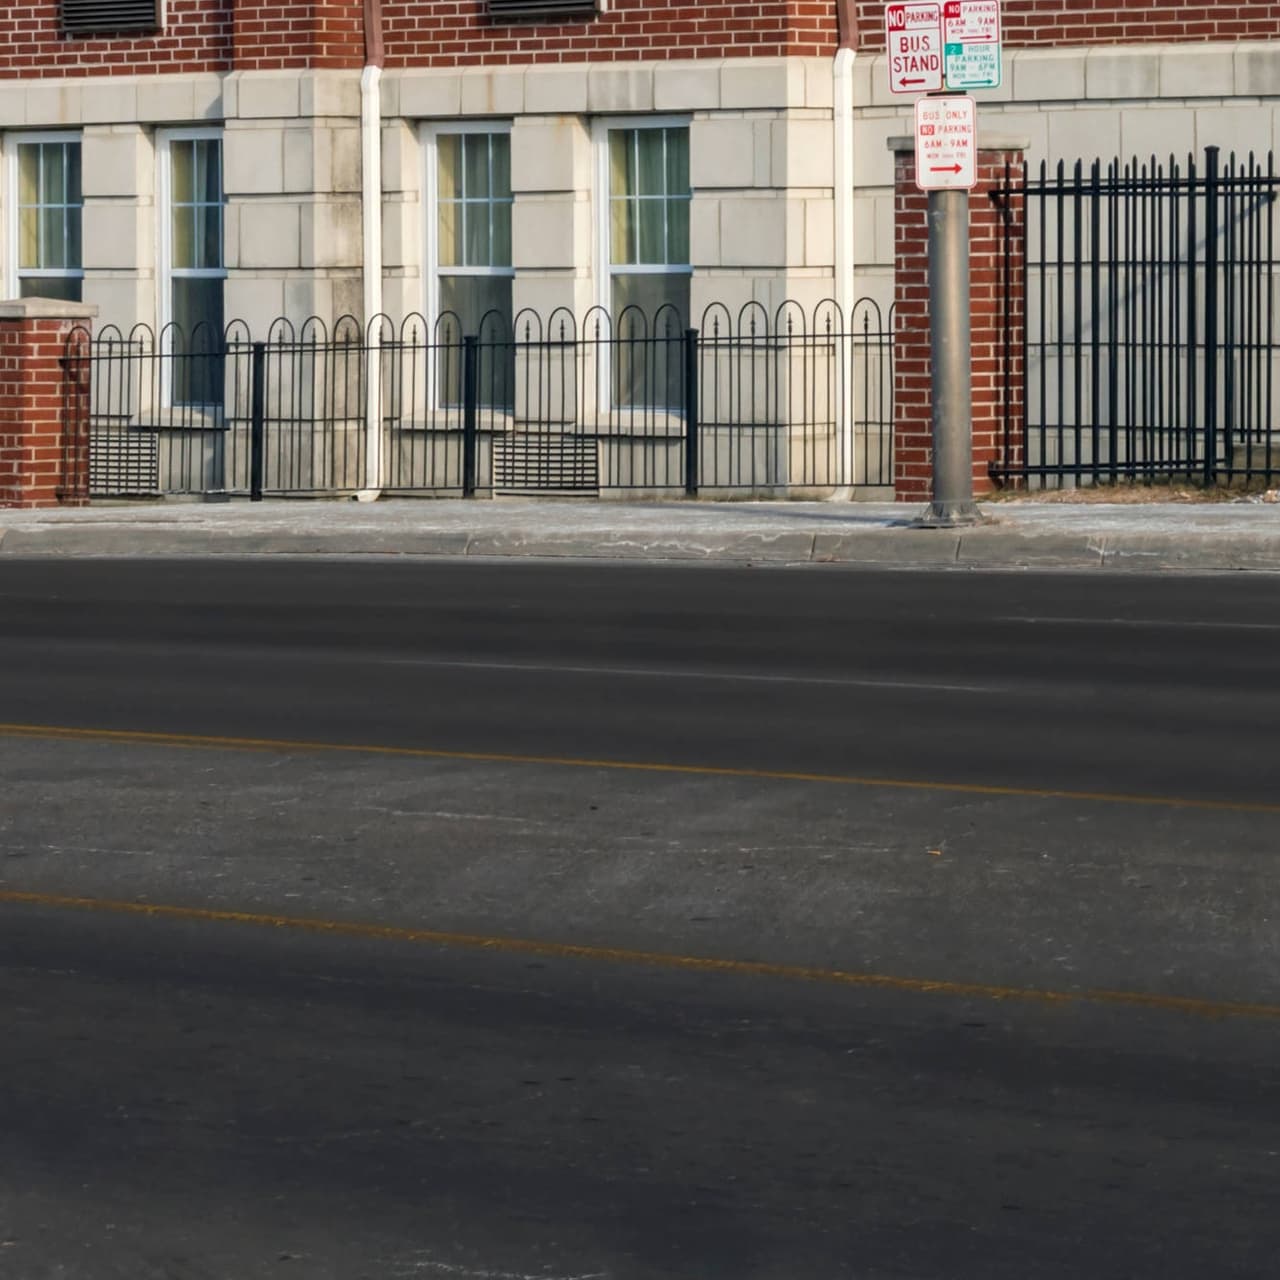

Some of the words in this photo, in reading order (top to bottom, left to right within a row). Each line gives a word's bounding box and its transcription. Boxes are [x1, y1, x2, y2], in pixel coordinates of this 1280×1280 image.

[948, 4, 960, 13] NO
[962, 4, 996, 13] PARKING
[888, 9, 905, 27] NO
[905, 10, 938, 23] PARKING
[900, 35, 930, 53] BUS
[893, 54, 939, 73] STAND
[922, 111, 940, 120] BUS
[945, 111, 967, 119] ONLY
[921, 125, 934, 135] NO
[938, 124, 971, 133] PARKING
